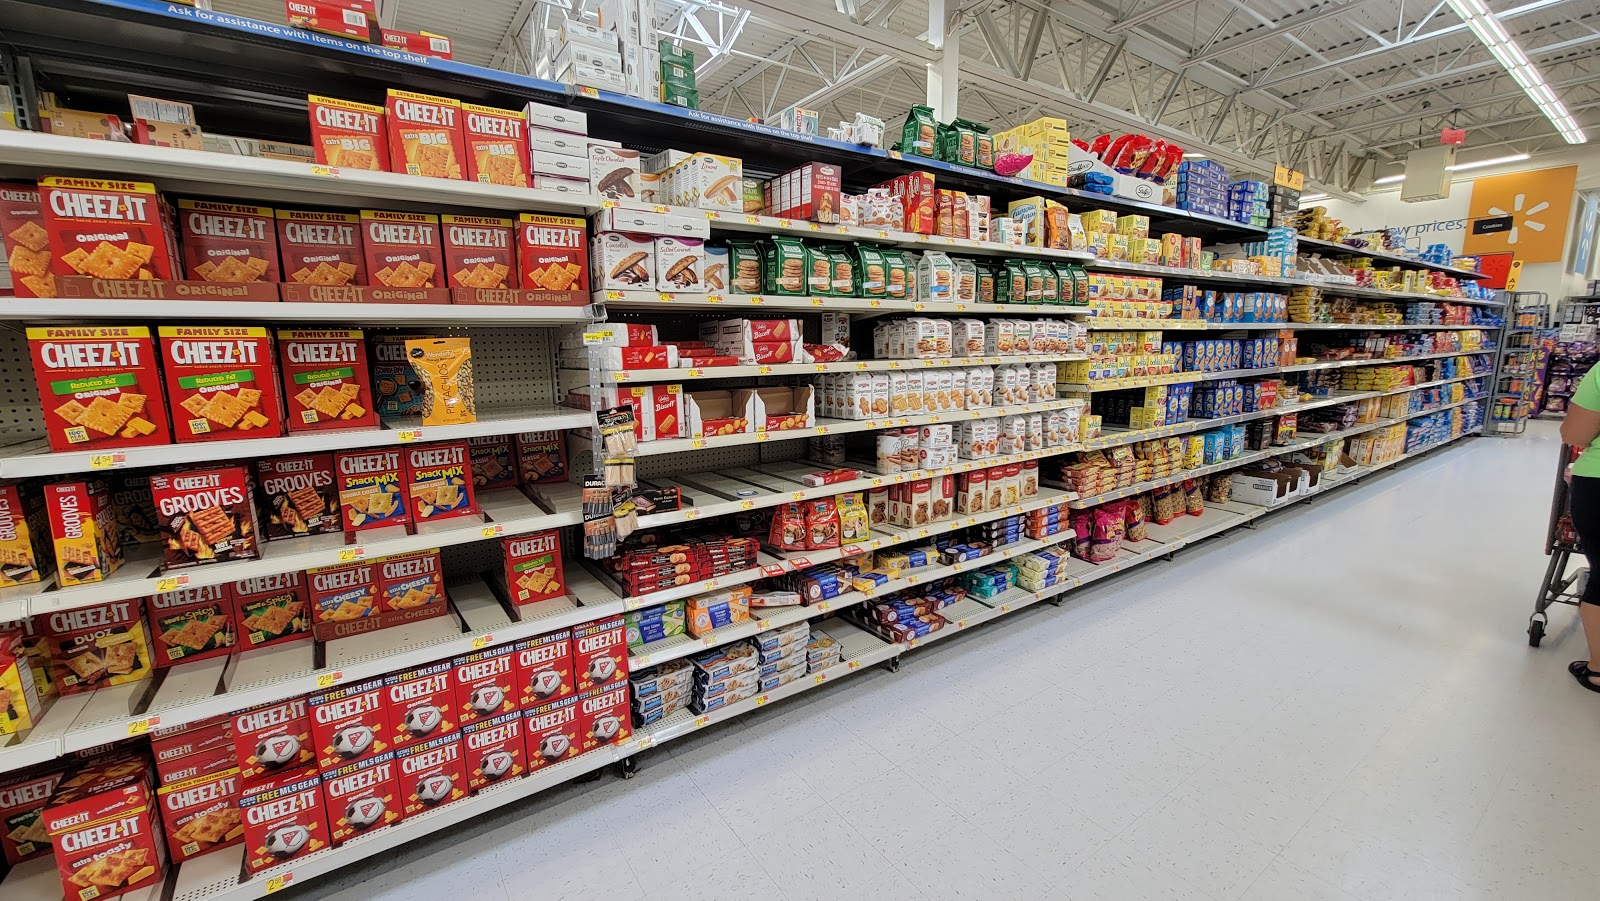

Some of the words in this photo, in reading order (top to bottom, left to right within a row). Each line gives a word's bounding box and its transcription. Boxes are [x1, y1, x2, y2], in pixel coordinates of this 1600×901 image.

[168, 5, 193, 17] Ask
[195, 10, 214, 22] for
[217, 15, 281, 35] assistance
[283, 26, 309, 42] with
[312, 34, 343, 48] items
[346, 42, 361, 51] on
[362, 44, 381, 55] the
[382, 48, 401, 61] top
[402, 52, 430, 65] shelf.
[394, 90, 415, 100] EXTRA
[416, 93, 425, 102] BIG
[426, 95, 453, 105] TASTINESS
[688, 110, 700, 119] Ask
[700, 113, 710, 121] for
[710, 115, 741, 127] assistance
[742, 121, 756, 130] with
[756, 124, 772, 134] items
[772, 128, 780, 136] on
[780, 129, 790, 137] the
[341, 137, 371, 151] BIG
[404, 132, 419, 140] extra
[419, 132, 447, 145] BIG
[490, 142, 515, 156] BIG
[55, 178, 104, 189] FAMILY
[107, 181, 136, 190] SIZE
[194, 202, 232, 212] FAMILY
[235, 205, 259, 214] SIZE
[290, 211, 325, 220] FAMILY
[327, 213, 347, 221] SIZE
[374, 211, 405, 220] FAMILY
[453, 216, 482, 224] FAMILY
[484, 217, 502, 225] SIZE
[530, 214, 558, 223] FAMILY
[559, 216, 576, 225] SIZE
[1415, 219, 1467, 237] prices.
[47, 328, 97, 338] FAMILY
[100, 327, 129, 337] SIZE
[176, 328, 219, 336] FAMILY
[223, 327, 249, 336] SIZE
[292, 331, 325, 339] FAMILY
[327, 330, 350, 338] SIZE
[70, 380, 103, 390] REDUCED
[105, 377, 117, 386] FAT
[195, 376, 225, 385] REDUCED
[225, 373, 237, 382] FAT
[263, 470, 333, 495] GROOVES
[429, 481, 446, 489] CHEESE
[361, 487, 379, 497] CHEESE
[159, 486, 244, 516] GROOVES
[59, 494, 83, 539] GROOVES
[400, 576, 431, 592] CHEESY
[266, 592, 293, 610] Spicy
[333, 587, 367, 604] CHEESY
[185, 606, 216, 623] Spicy
[74, 627, 114, 646] DUOZ
[399, 671, 418, 682] FREE
[417, 666, 433, 677] MLS
[432, 662, 451, 674] GEAR
[325, 690, 346, 703] FREE
[345, 684, 363, 697] MLS
[362, 679, 383, 692] GEAR
[192, 771, 230, 785] TOASTINESS
[176, 814, 194, 826] extra
[194, 801, 230, 820] toasty
[72, 855, 92, 868] extra
[92, 841, 132, 862] toasty
